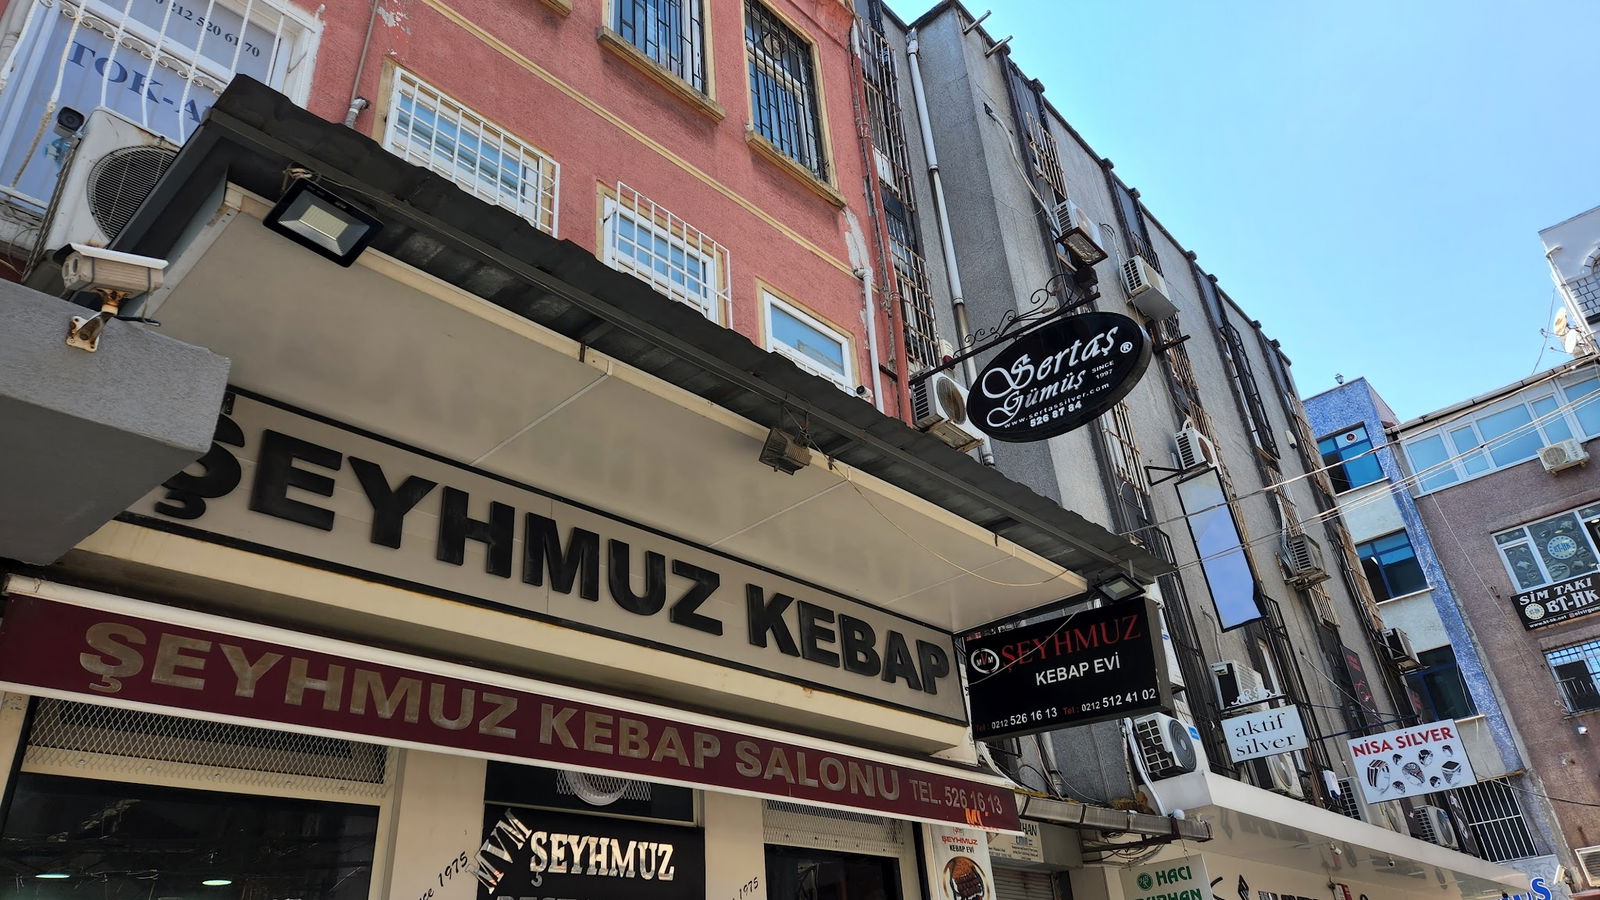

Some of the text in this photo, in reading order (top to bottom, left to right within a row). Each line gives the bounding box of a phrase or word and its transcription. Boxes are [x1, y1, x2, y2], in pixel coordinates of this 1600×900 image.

[196, 17, 221, 36] 520
[245, 42, 260, 57] 70
[981, 327, 1118, 399] Sertaş
[1091, 360, 1114, 374] SINCE
[1096, 369, 1113, 380] 1997
[987, 370, 1086, 427] Gümüş
[1004, 383, 1109, 428] www.sertassilver.com
[1030, 400, 1082, 427] 526 87 84
[1519, 577, 1592, 606] SİM TAKI
[1545, 589, 1600, 613] BT-HK
[746, 583, 949, 695] KEBAP
[1001, 614, 1141, 673] ŞEYHMUZ
[1035, 652, 1121, 686] KEBAP EVİ
[79, 622, 1003, 815] ŞEYHMUZ KEBAP SALONU TEL. 526 16 13
[991, 719, 1009, 730] 0212
[1010, 713, 1028, 726] 526
[1030, 710, 1043, 721] 16
[1045, 707, 1058, 719] 13
[1081, 701, 1101, 713] 0212
[1102, 694, 1122, 708] 512
[1125, 691, 1138, 703] 41
[1142, 688, 1157, 700] 02
[1235, 712, 1285, 738] aktif
[1236, 734, 1296, 757] silver
[1352, 727, 1454, 757] NİSA SİLVER
[465, 807, 532, 894] MVM
[530, 831, 675, 887] ŞEYHMUZ
[438, 851, 468, 887] 1975
[1155, 865, 1192, 887] HACI
[739, 876, 759, 900] 1975
